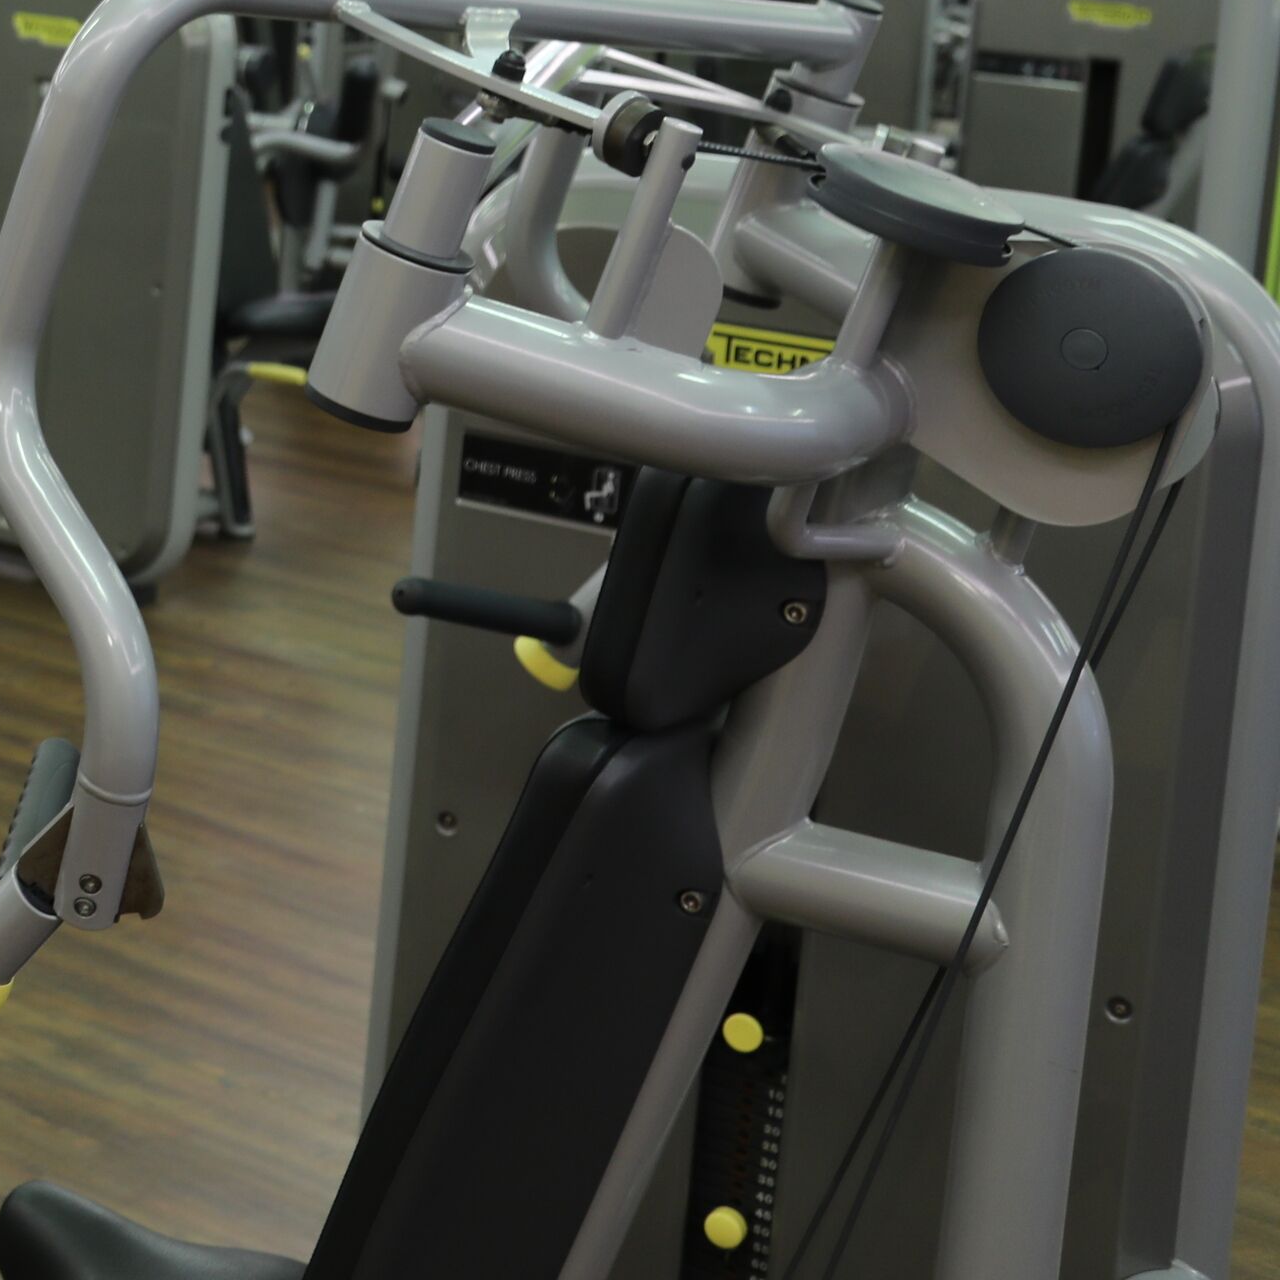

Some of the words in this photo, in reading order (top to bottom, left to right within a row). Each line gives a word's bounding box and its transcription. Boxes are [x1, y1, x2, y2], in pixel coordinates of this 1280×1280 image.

[463, 458, 500, 477] CHEST
[504, 466, 536, 486] PRESS
[769, 1089, 785, 1102] 10
